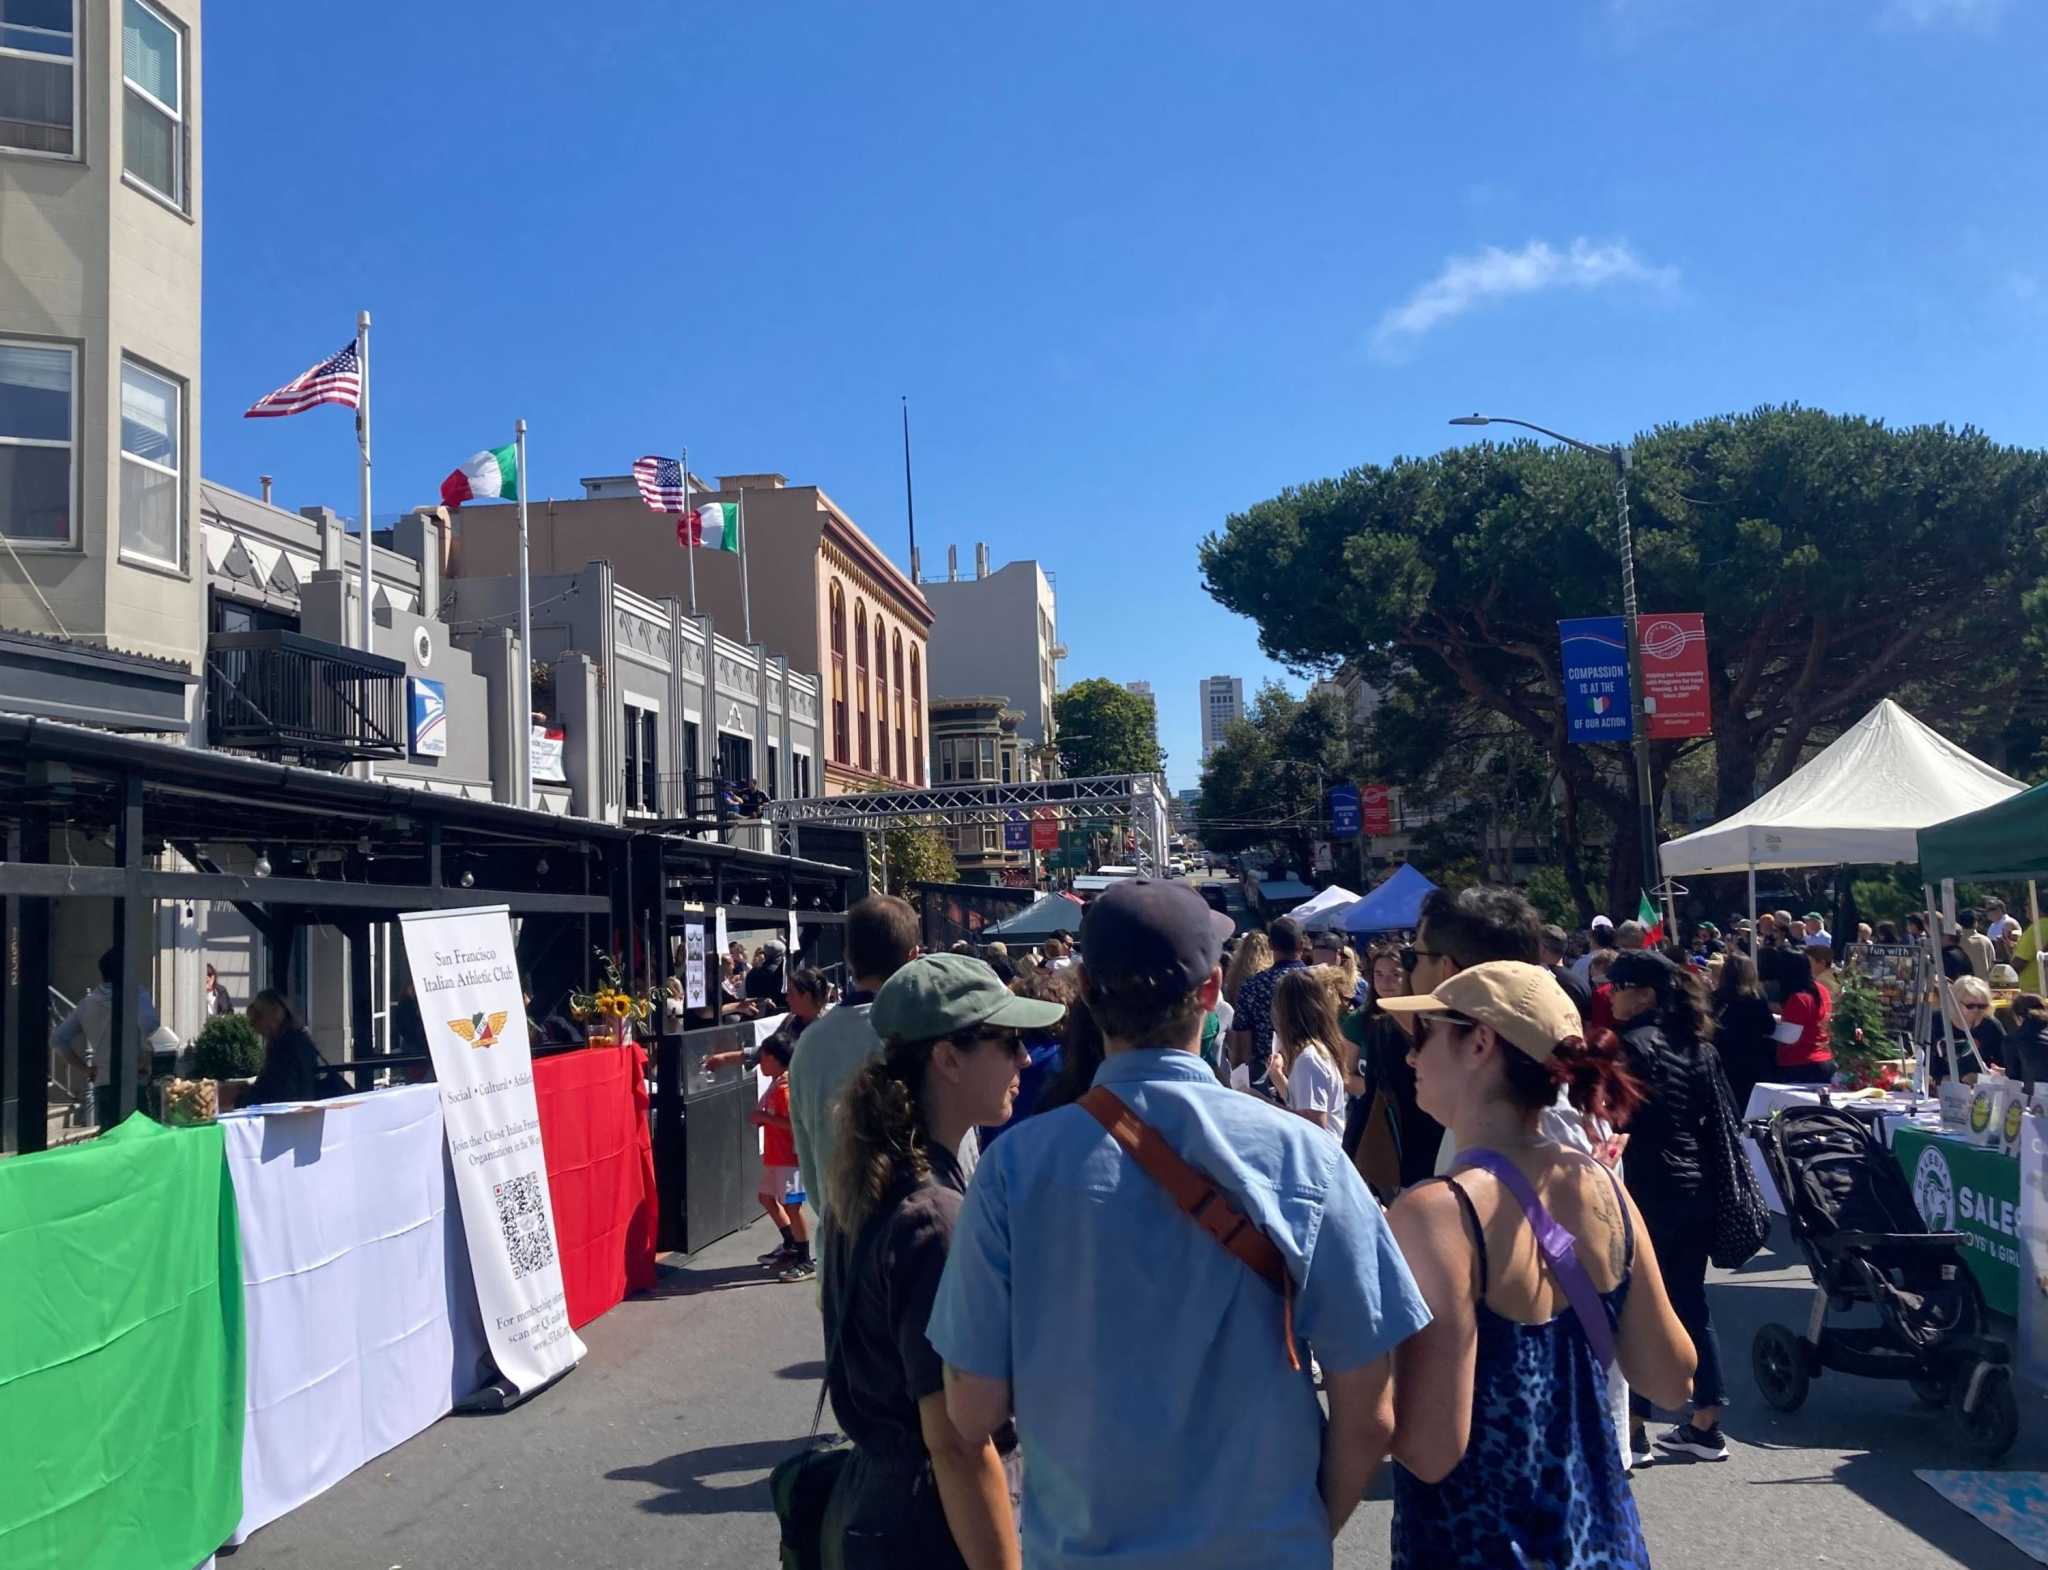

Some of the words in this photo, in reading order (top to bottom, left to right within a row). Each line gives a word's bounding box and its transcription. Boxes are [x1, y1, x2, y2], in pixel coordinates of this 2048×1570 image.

[1568, 666, 1624, 680] COMPASSION
[1579, 683, 1588, 695] IS
[1590, 682, 1600, 693] AT
[1601, 681, 1615, 692] THE
[1574, 718, 1584, 729] OF
[1585, 718, 1600, 728] OUR
[1601, 717, 1627, 728] ACTION
[433, 951, 453, 967] San
[453, 946, 497, 965] Francisco
[1870, 946, 1885, 956] fun
[1887, 946, 1909, 956] with
[422, 975, 456, 993] Italian
[457, 969, 492, 987] Athletic
[493, 965, 514, 981] Club
[447, 1086, 472, 1105] Social
[451, 1137, 469, 1156] Join
[1989, 1242, 1997, 1258] &
[496, 1315, 514, 1331] For
[508, 1328, 530, 1344] scan
